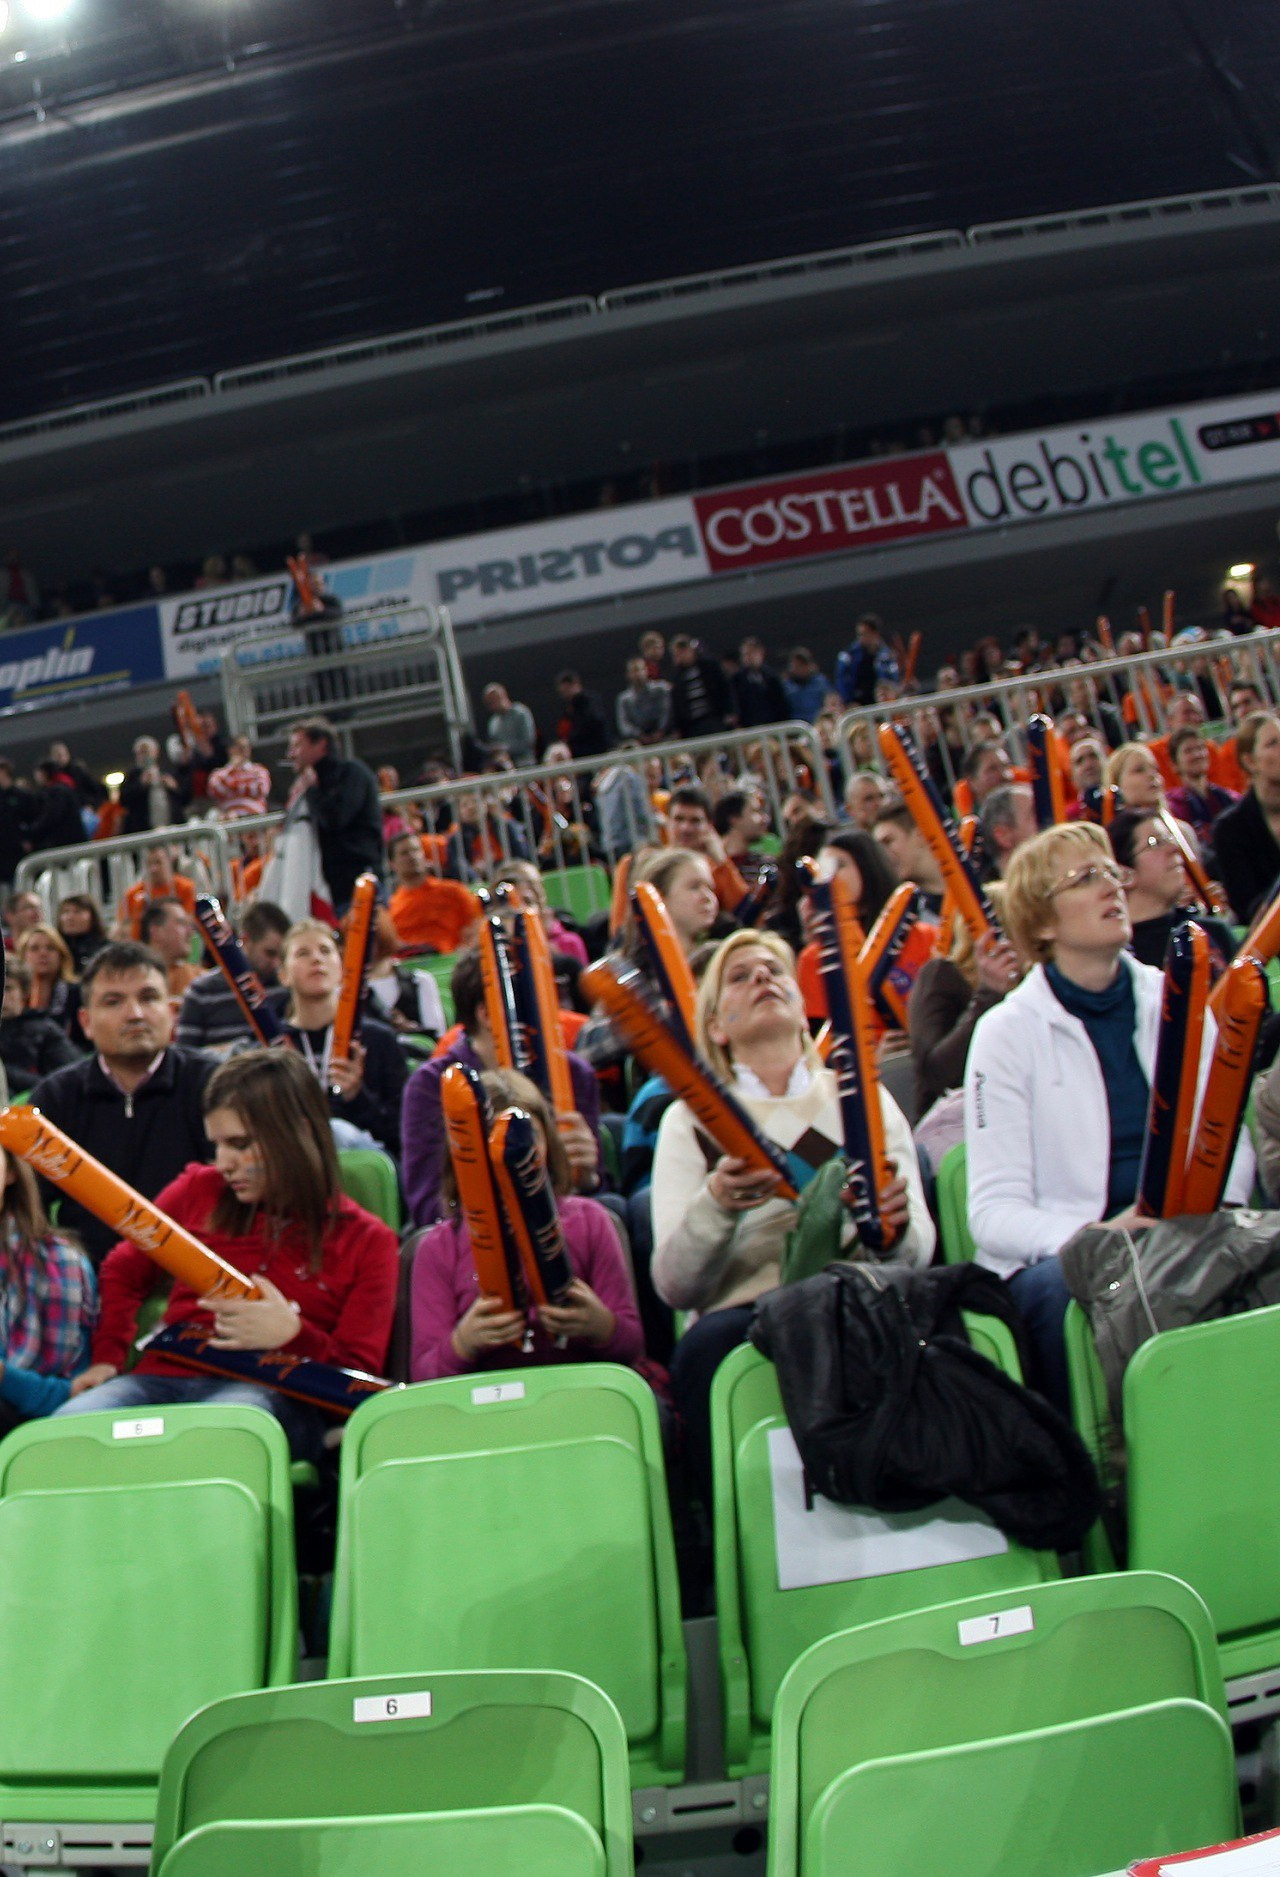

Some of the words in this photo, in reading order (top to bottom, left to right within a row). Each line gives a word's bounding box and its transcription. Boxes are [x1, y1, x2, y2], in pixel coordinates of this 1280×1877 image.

[967, 417, 1202, 522] debitel
[705, 476, 962, 557] COSTELLA
[177, 587, 288, 633] STUDIO
[989, 1616, 1000, 1635] 7
[385, 1697, 399, 1716] 6
